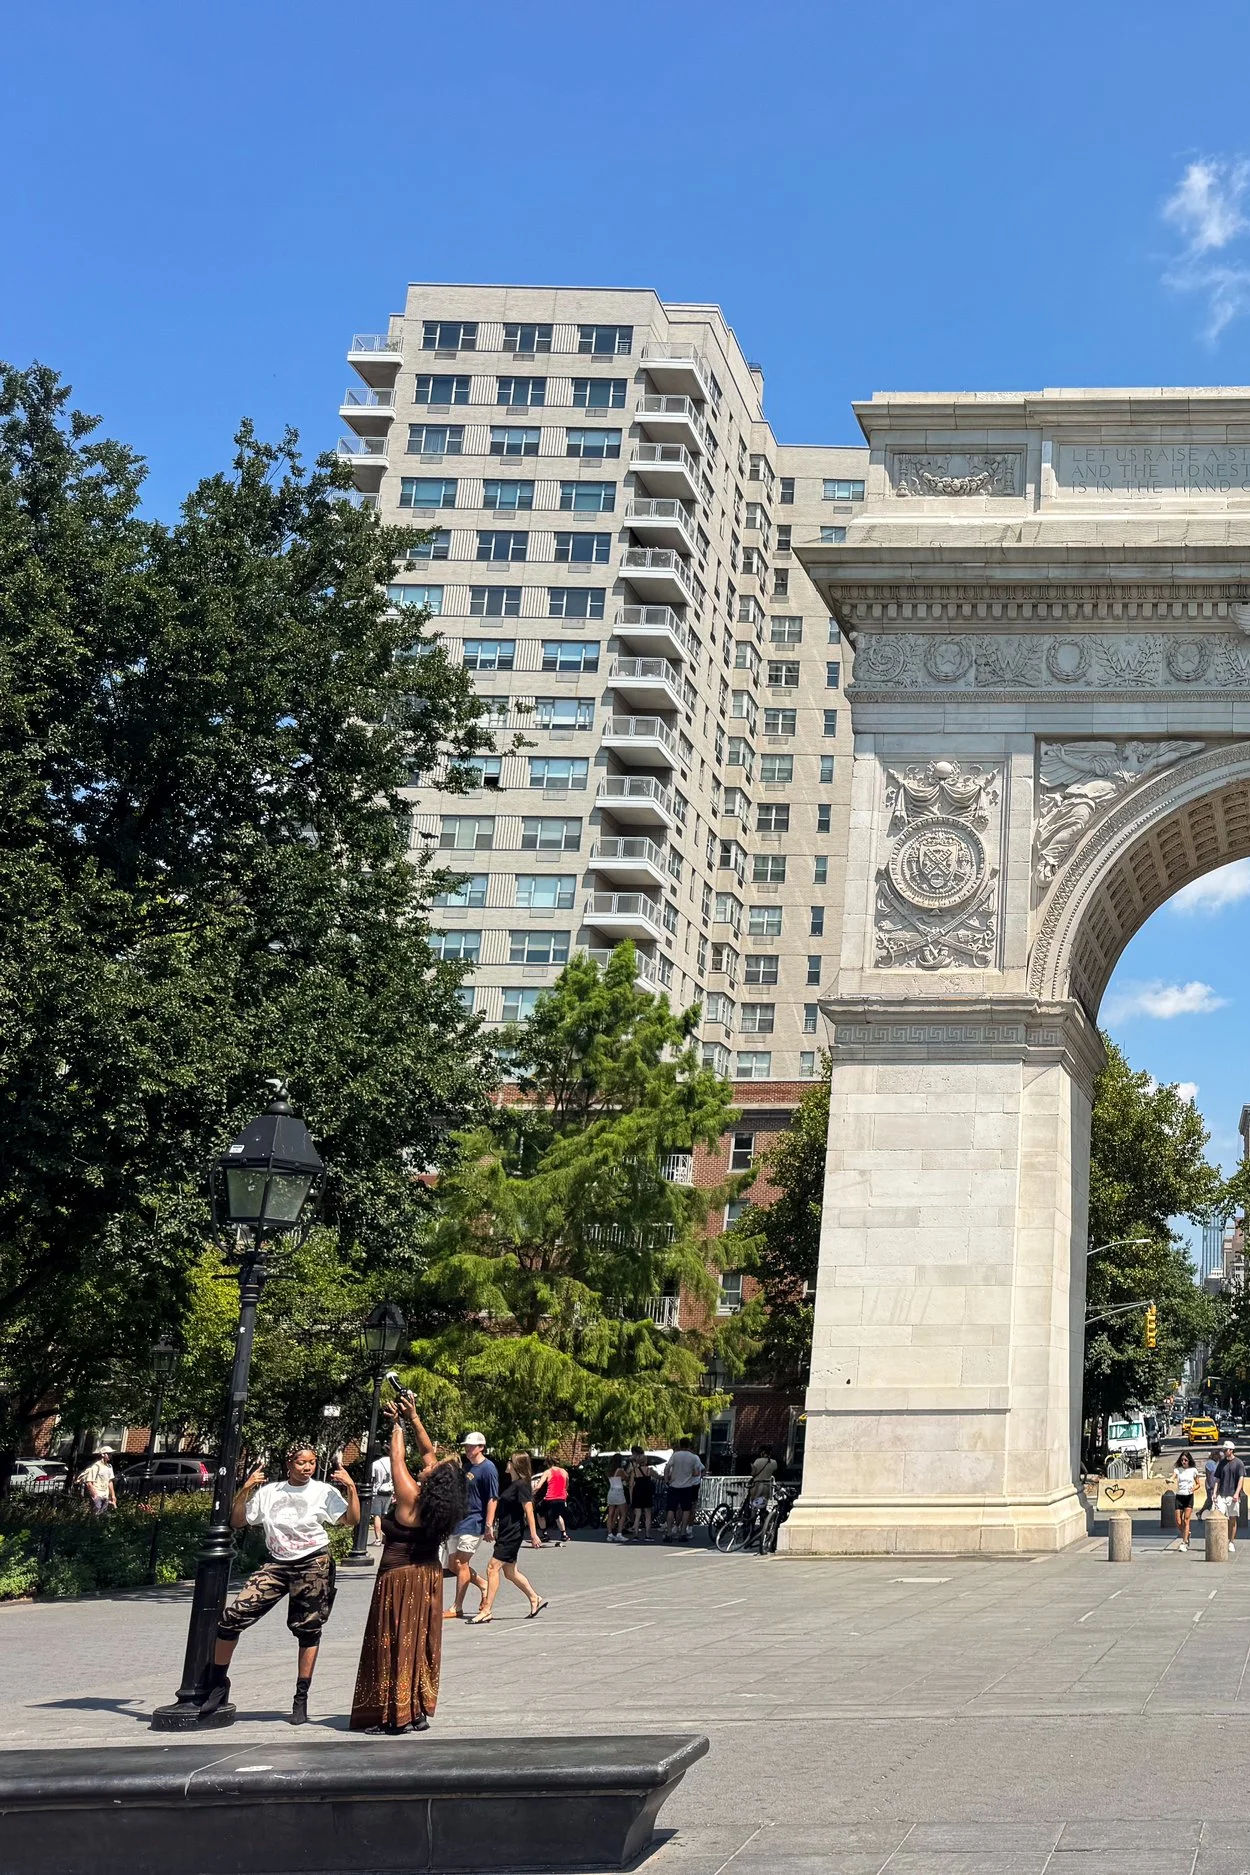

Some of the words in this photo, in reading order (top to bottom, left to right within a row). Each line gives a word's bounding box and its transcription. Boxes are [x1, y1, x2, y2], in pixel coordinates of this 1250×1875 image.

[1072, 448, 1111, 462] LET
[1115, 448, 1137, 462] US
[1143, 447, 1199, 462] RAISE
[1206, 447, 1219, 461] A
[1072, 464, 1111, 478] AND
[1119, 464, 1159, 478] THE
[1072, 480, 1087, 494] IS
[1096, 480, 1113, 494] IN
[1123, 480, 1163, 494] THE
[1174, 480, 1231, 493] HAND
